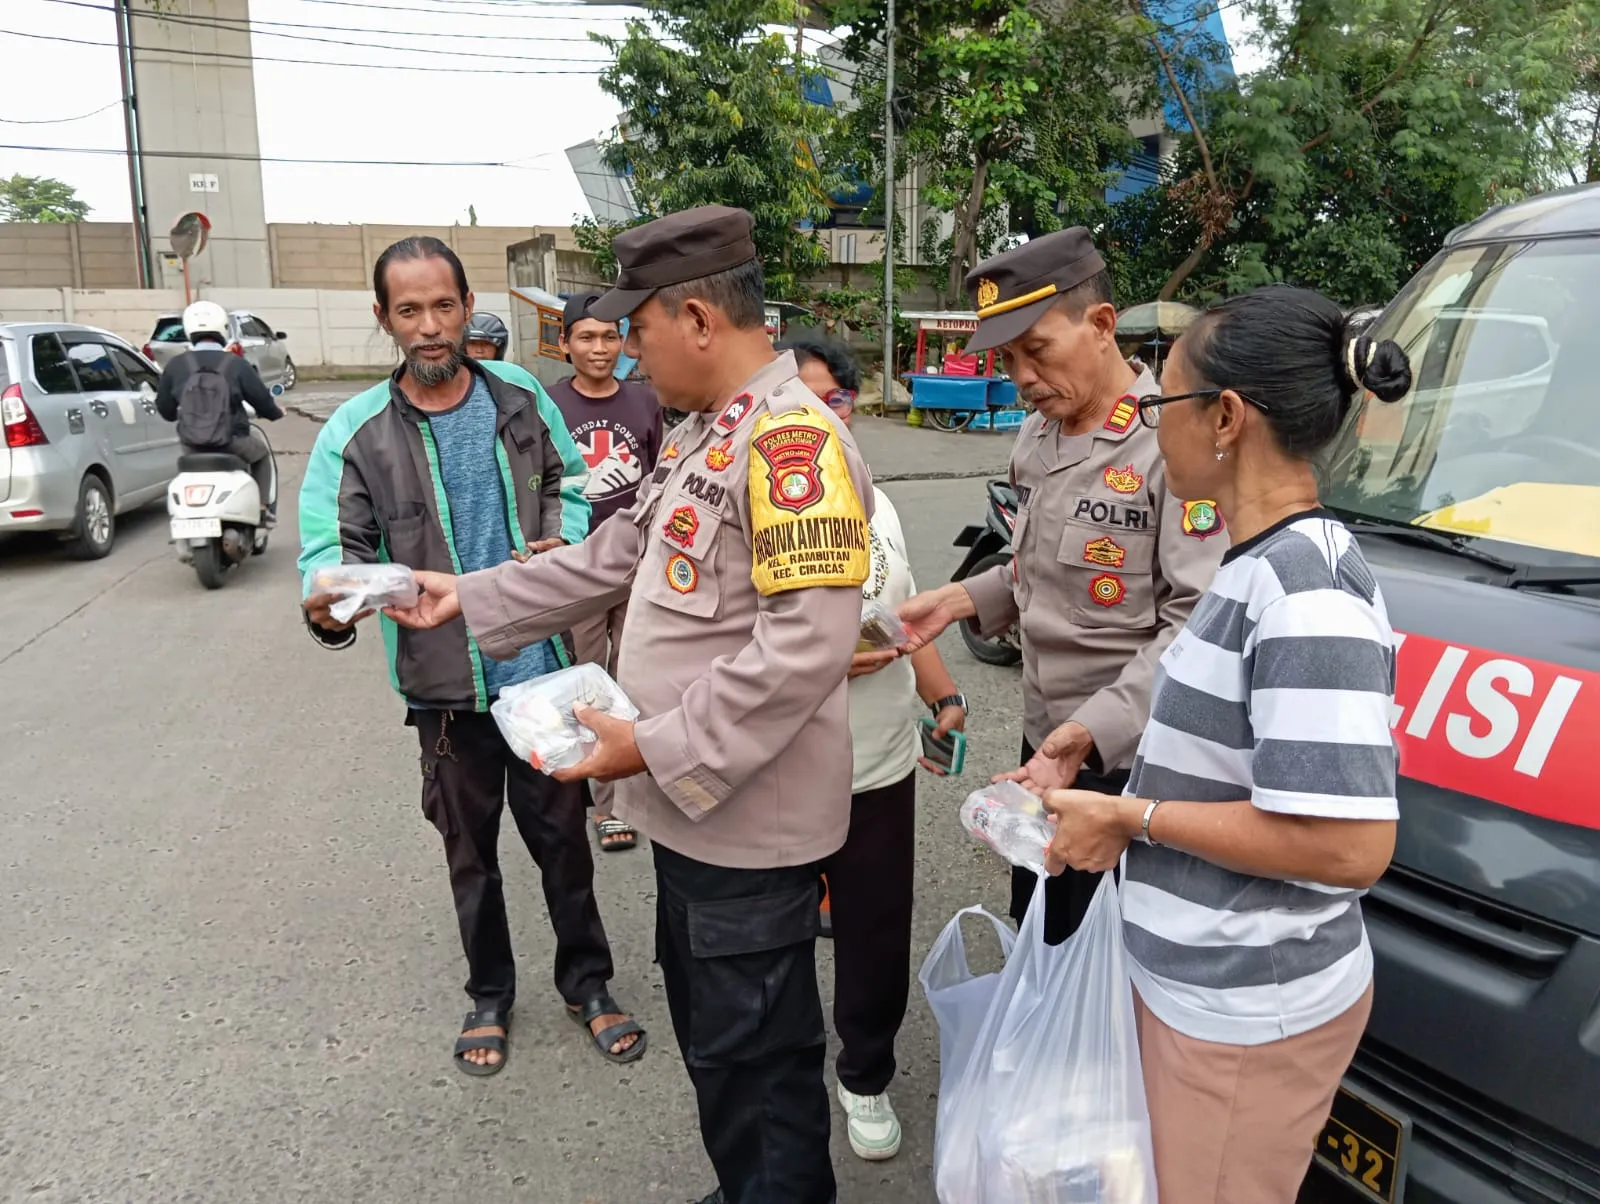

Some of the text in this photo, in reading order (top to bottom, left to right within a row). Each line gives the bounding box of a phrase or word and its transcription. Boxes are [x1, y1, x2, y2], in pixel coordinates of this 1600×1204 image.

[614, 423, 639, 450] COMES
[762, 430, 818, 448] POLRES METRO
[681, 472, 726, 507] POLRI
[1074, 499, 1149, 529] POLRI
[767, 551, 850, 570] KEL. RAMBUTAN
[773, 563, 845, 580] KEC. CIRACAS
[1390, 631, 1583, 779] ISI
[1312, 1132, 1383, 1193] -32
